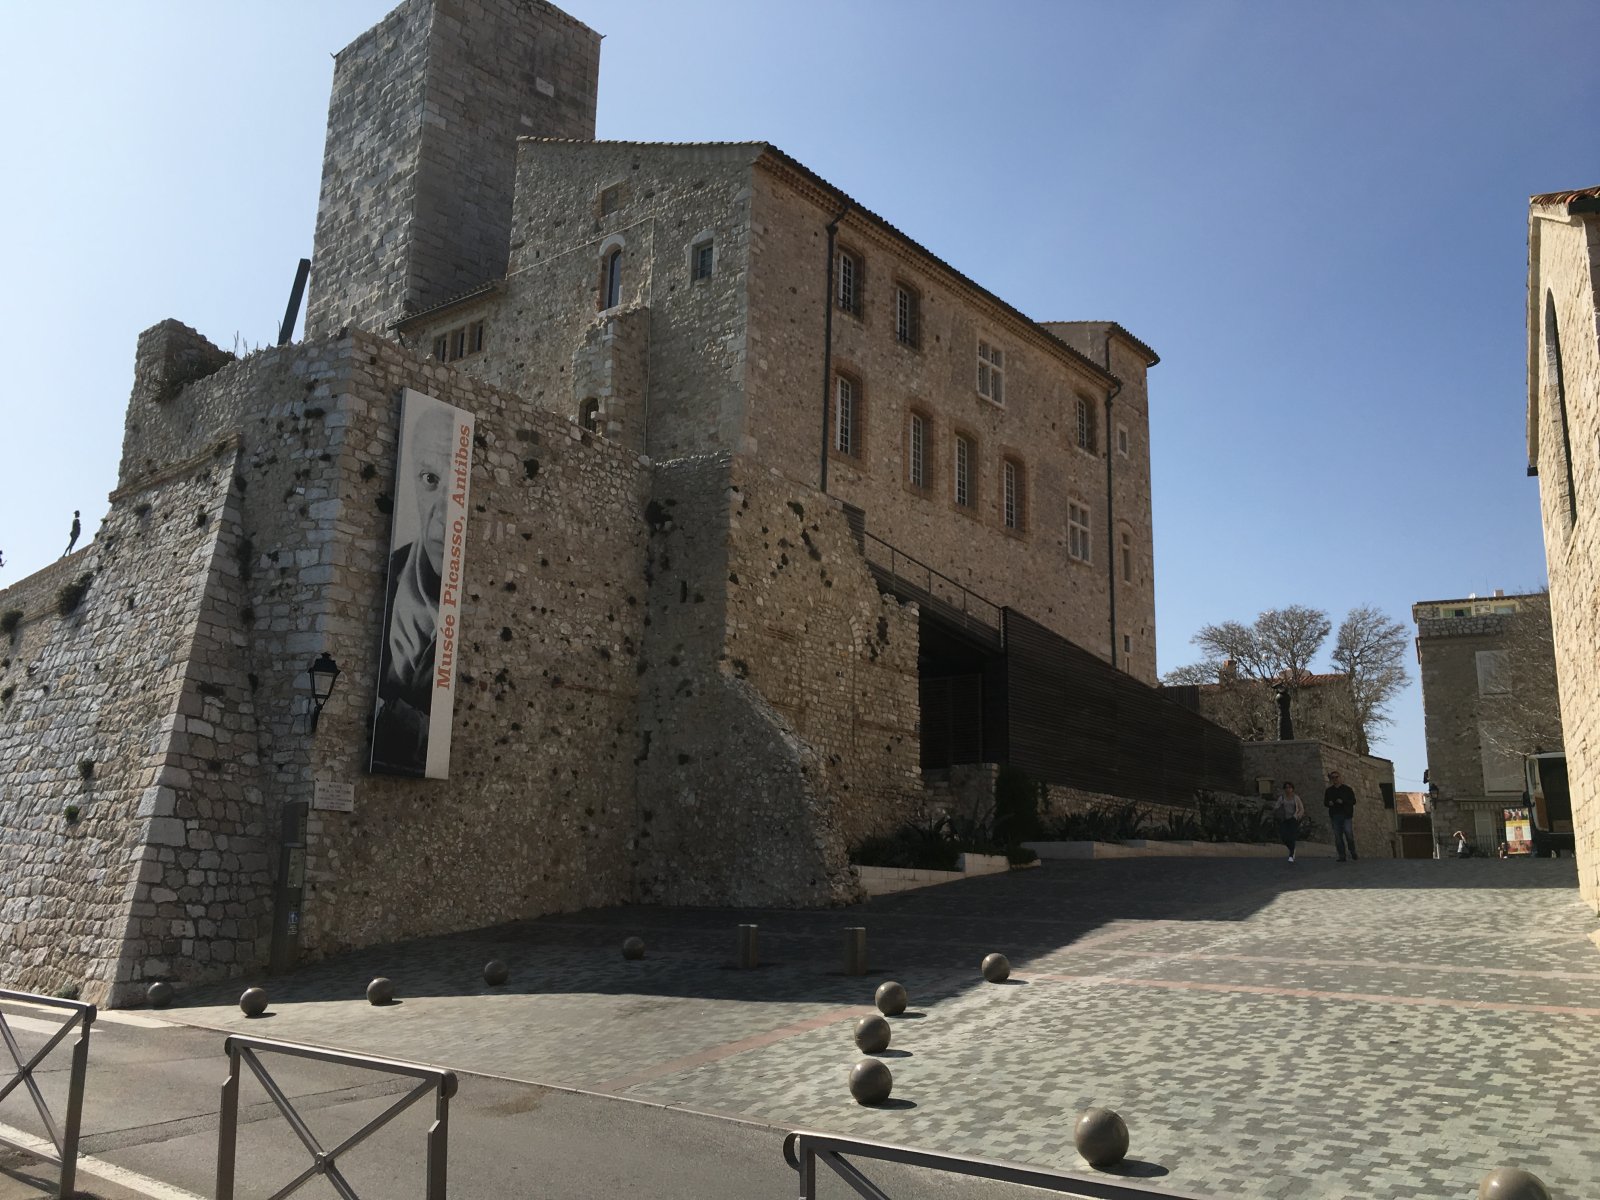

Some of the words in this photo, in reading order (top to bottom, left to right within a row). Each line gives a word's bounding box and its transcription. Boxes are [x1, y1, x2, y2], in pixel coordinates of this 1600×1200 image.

[452, 425, 470, 508] Antibes
[443, 515, 465, 608] Picasso,
[436, 615, 456, 689] Musée
